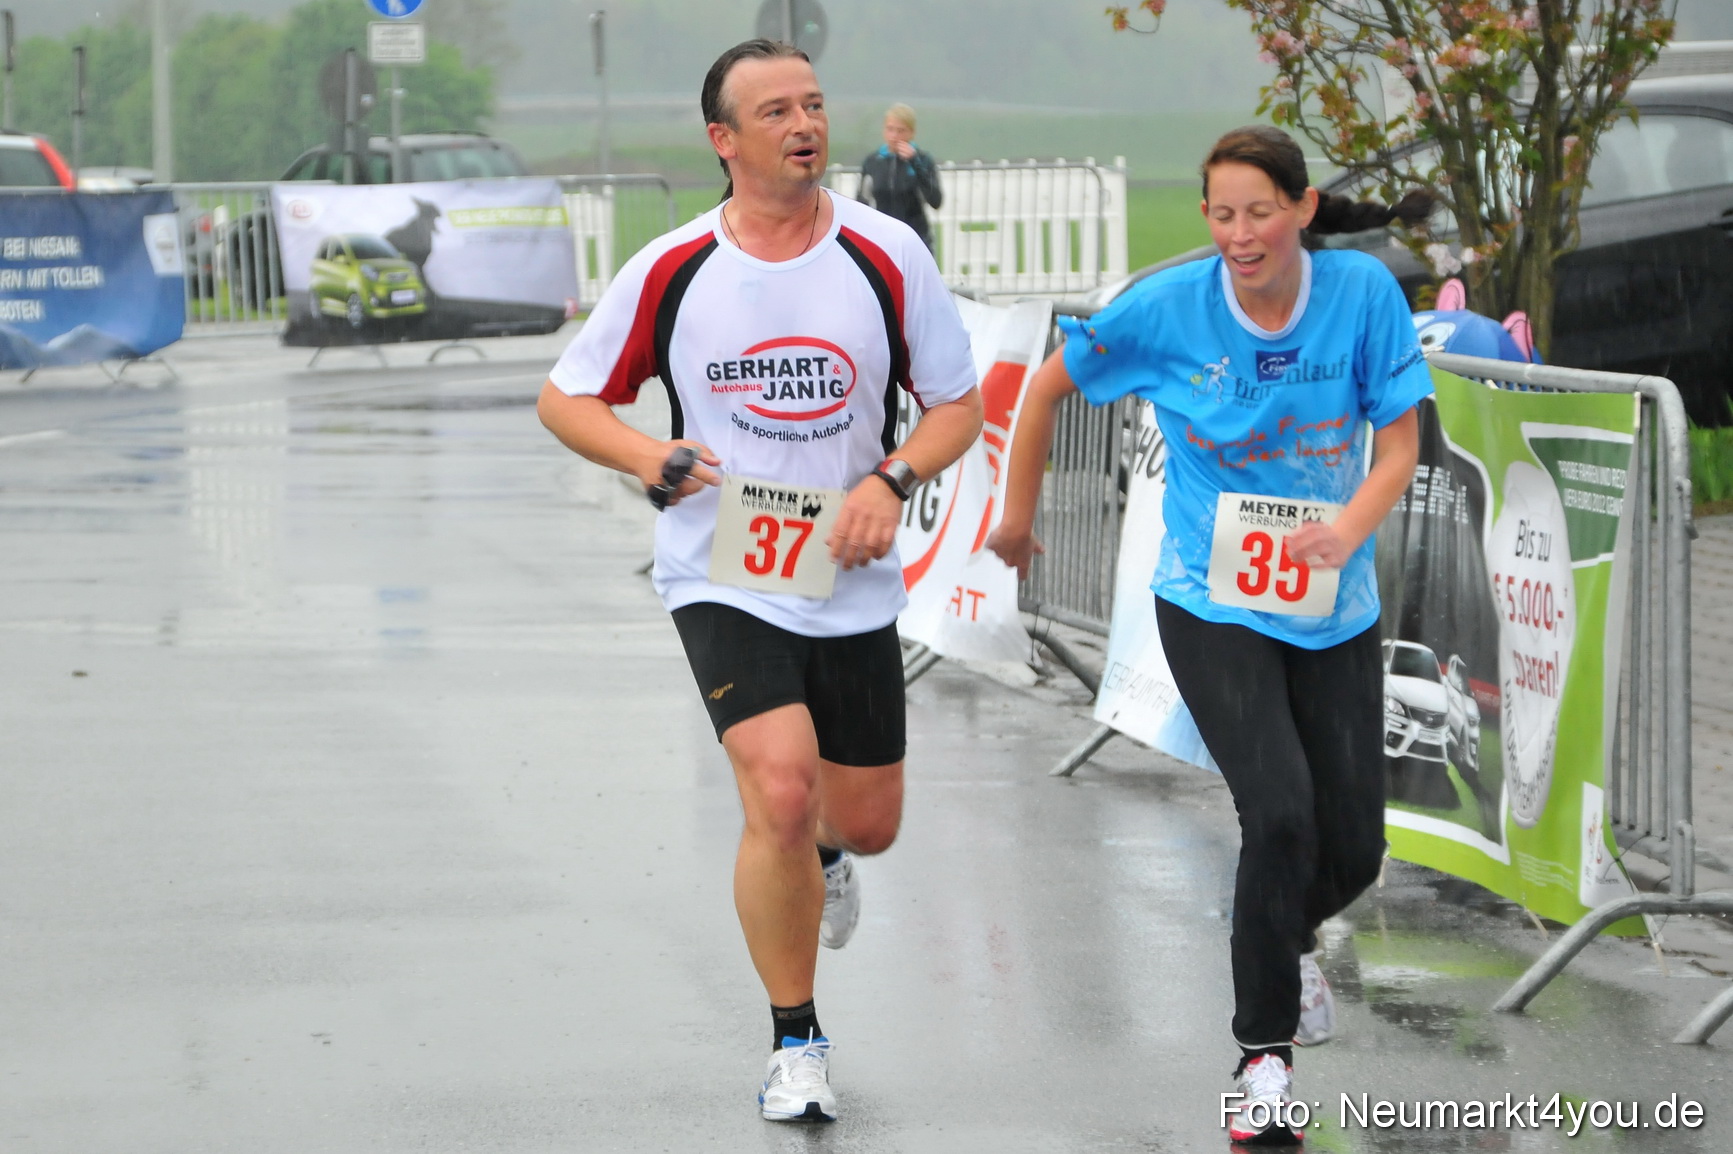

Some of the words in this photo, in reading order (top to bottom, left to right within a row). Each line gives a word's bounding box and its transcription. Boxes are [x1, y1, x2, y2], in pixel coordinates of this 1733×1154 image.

[26, 267, 48, 289] MIT
[50, 265, 102, 289] TOLLEN
[706, 356, 829, 382] GERHART
[832, 363, 842, 375] &
[711, 382, 763, 394] Autohaus
[762, 378, 846, 401] JÄNIG
[731, 412, 751, 431] Das
[752, 425, 809, 443] sportliche
[741, 495, 798, 515] WERBUNG
[742, 483, 798, 503] MEYER
[1238, 513, 1298, 529] WERBUNG
[1239, 499, 1298, 519] MEYER
[744, 514, 814, 578] 37
[1515, 519, 1535, 560] Bis
[1537, 532, 1551, 562] zu
[1236, 531, 1310, 603] 35
